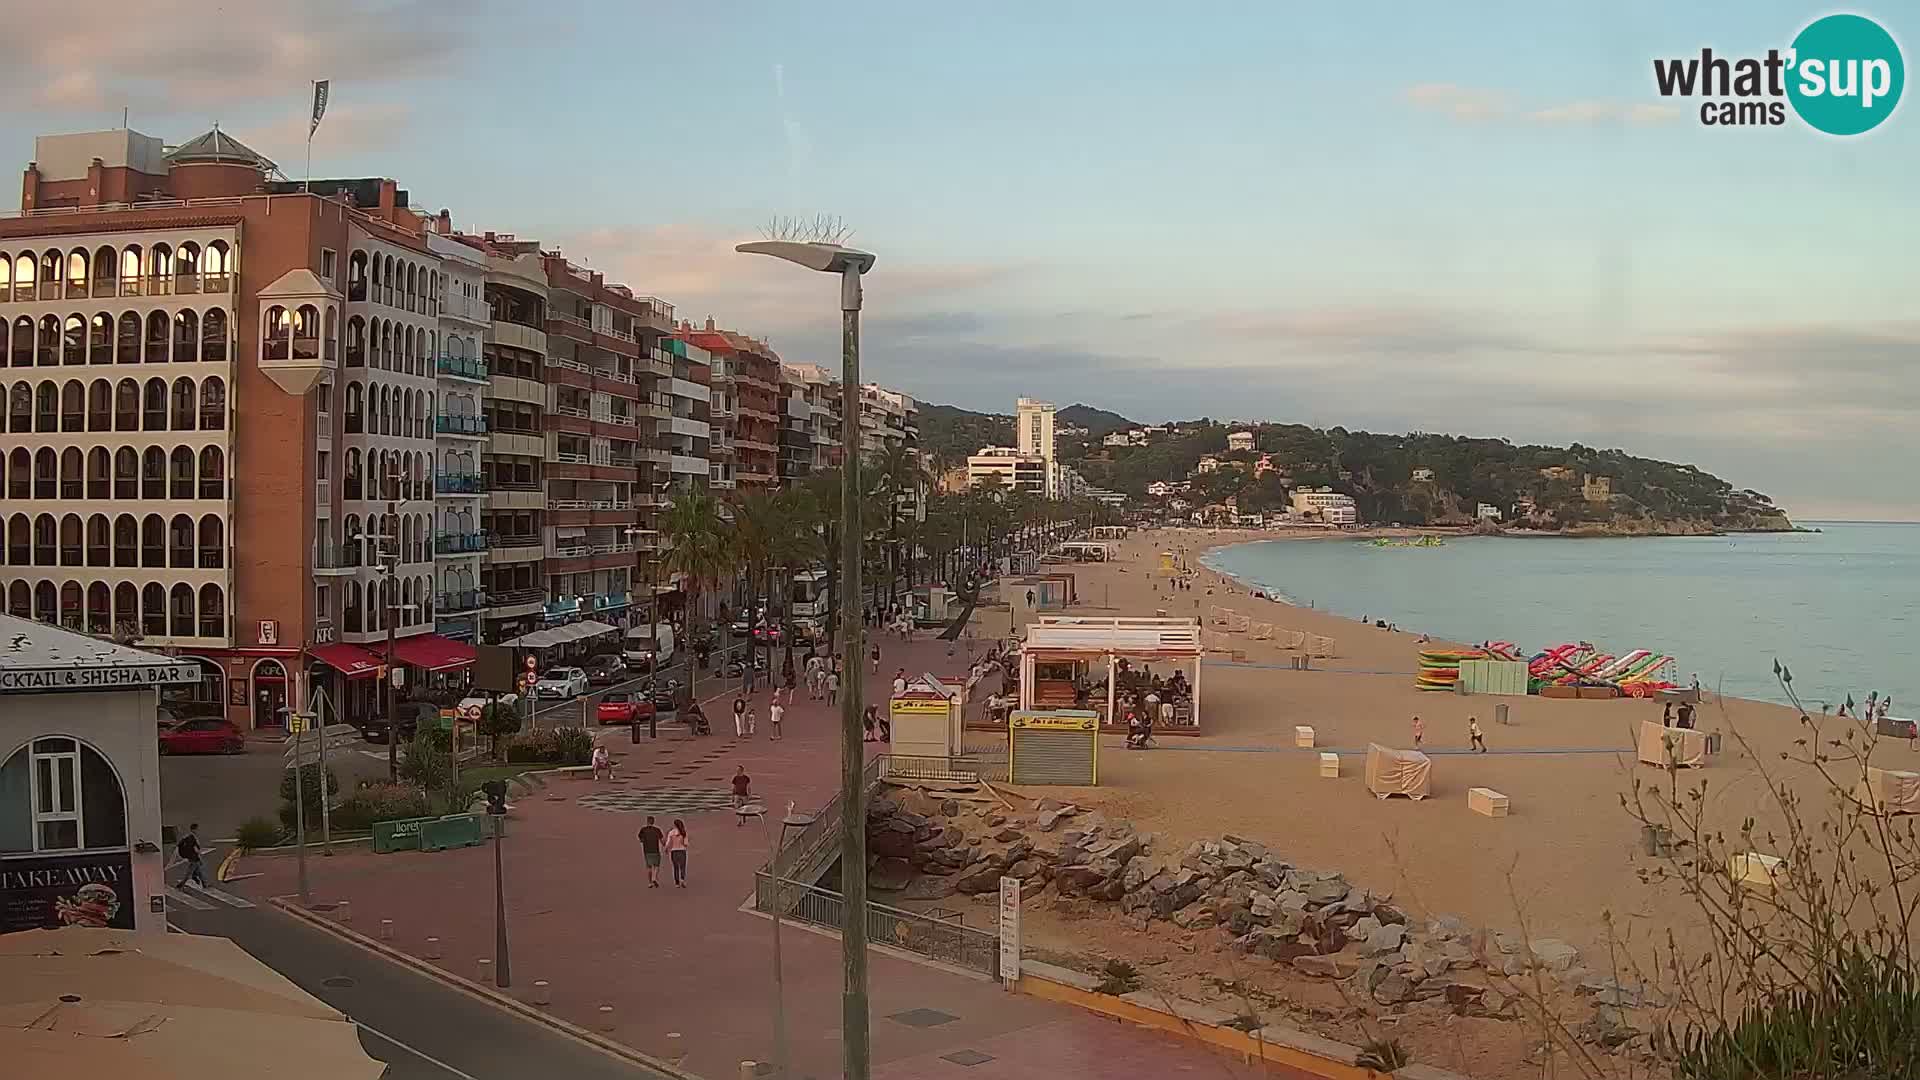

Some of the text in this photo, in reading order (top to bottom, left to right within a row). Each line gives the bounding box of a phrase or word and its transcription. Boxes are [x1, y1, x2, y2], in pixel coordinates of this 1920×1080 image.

[316, 627, 335, 644] KFC
[0, 665, 180, 688] CKTAIL & SHISHA BAR
